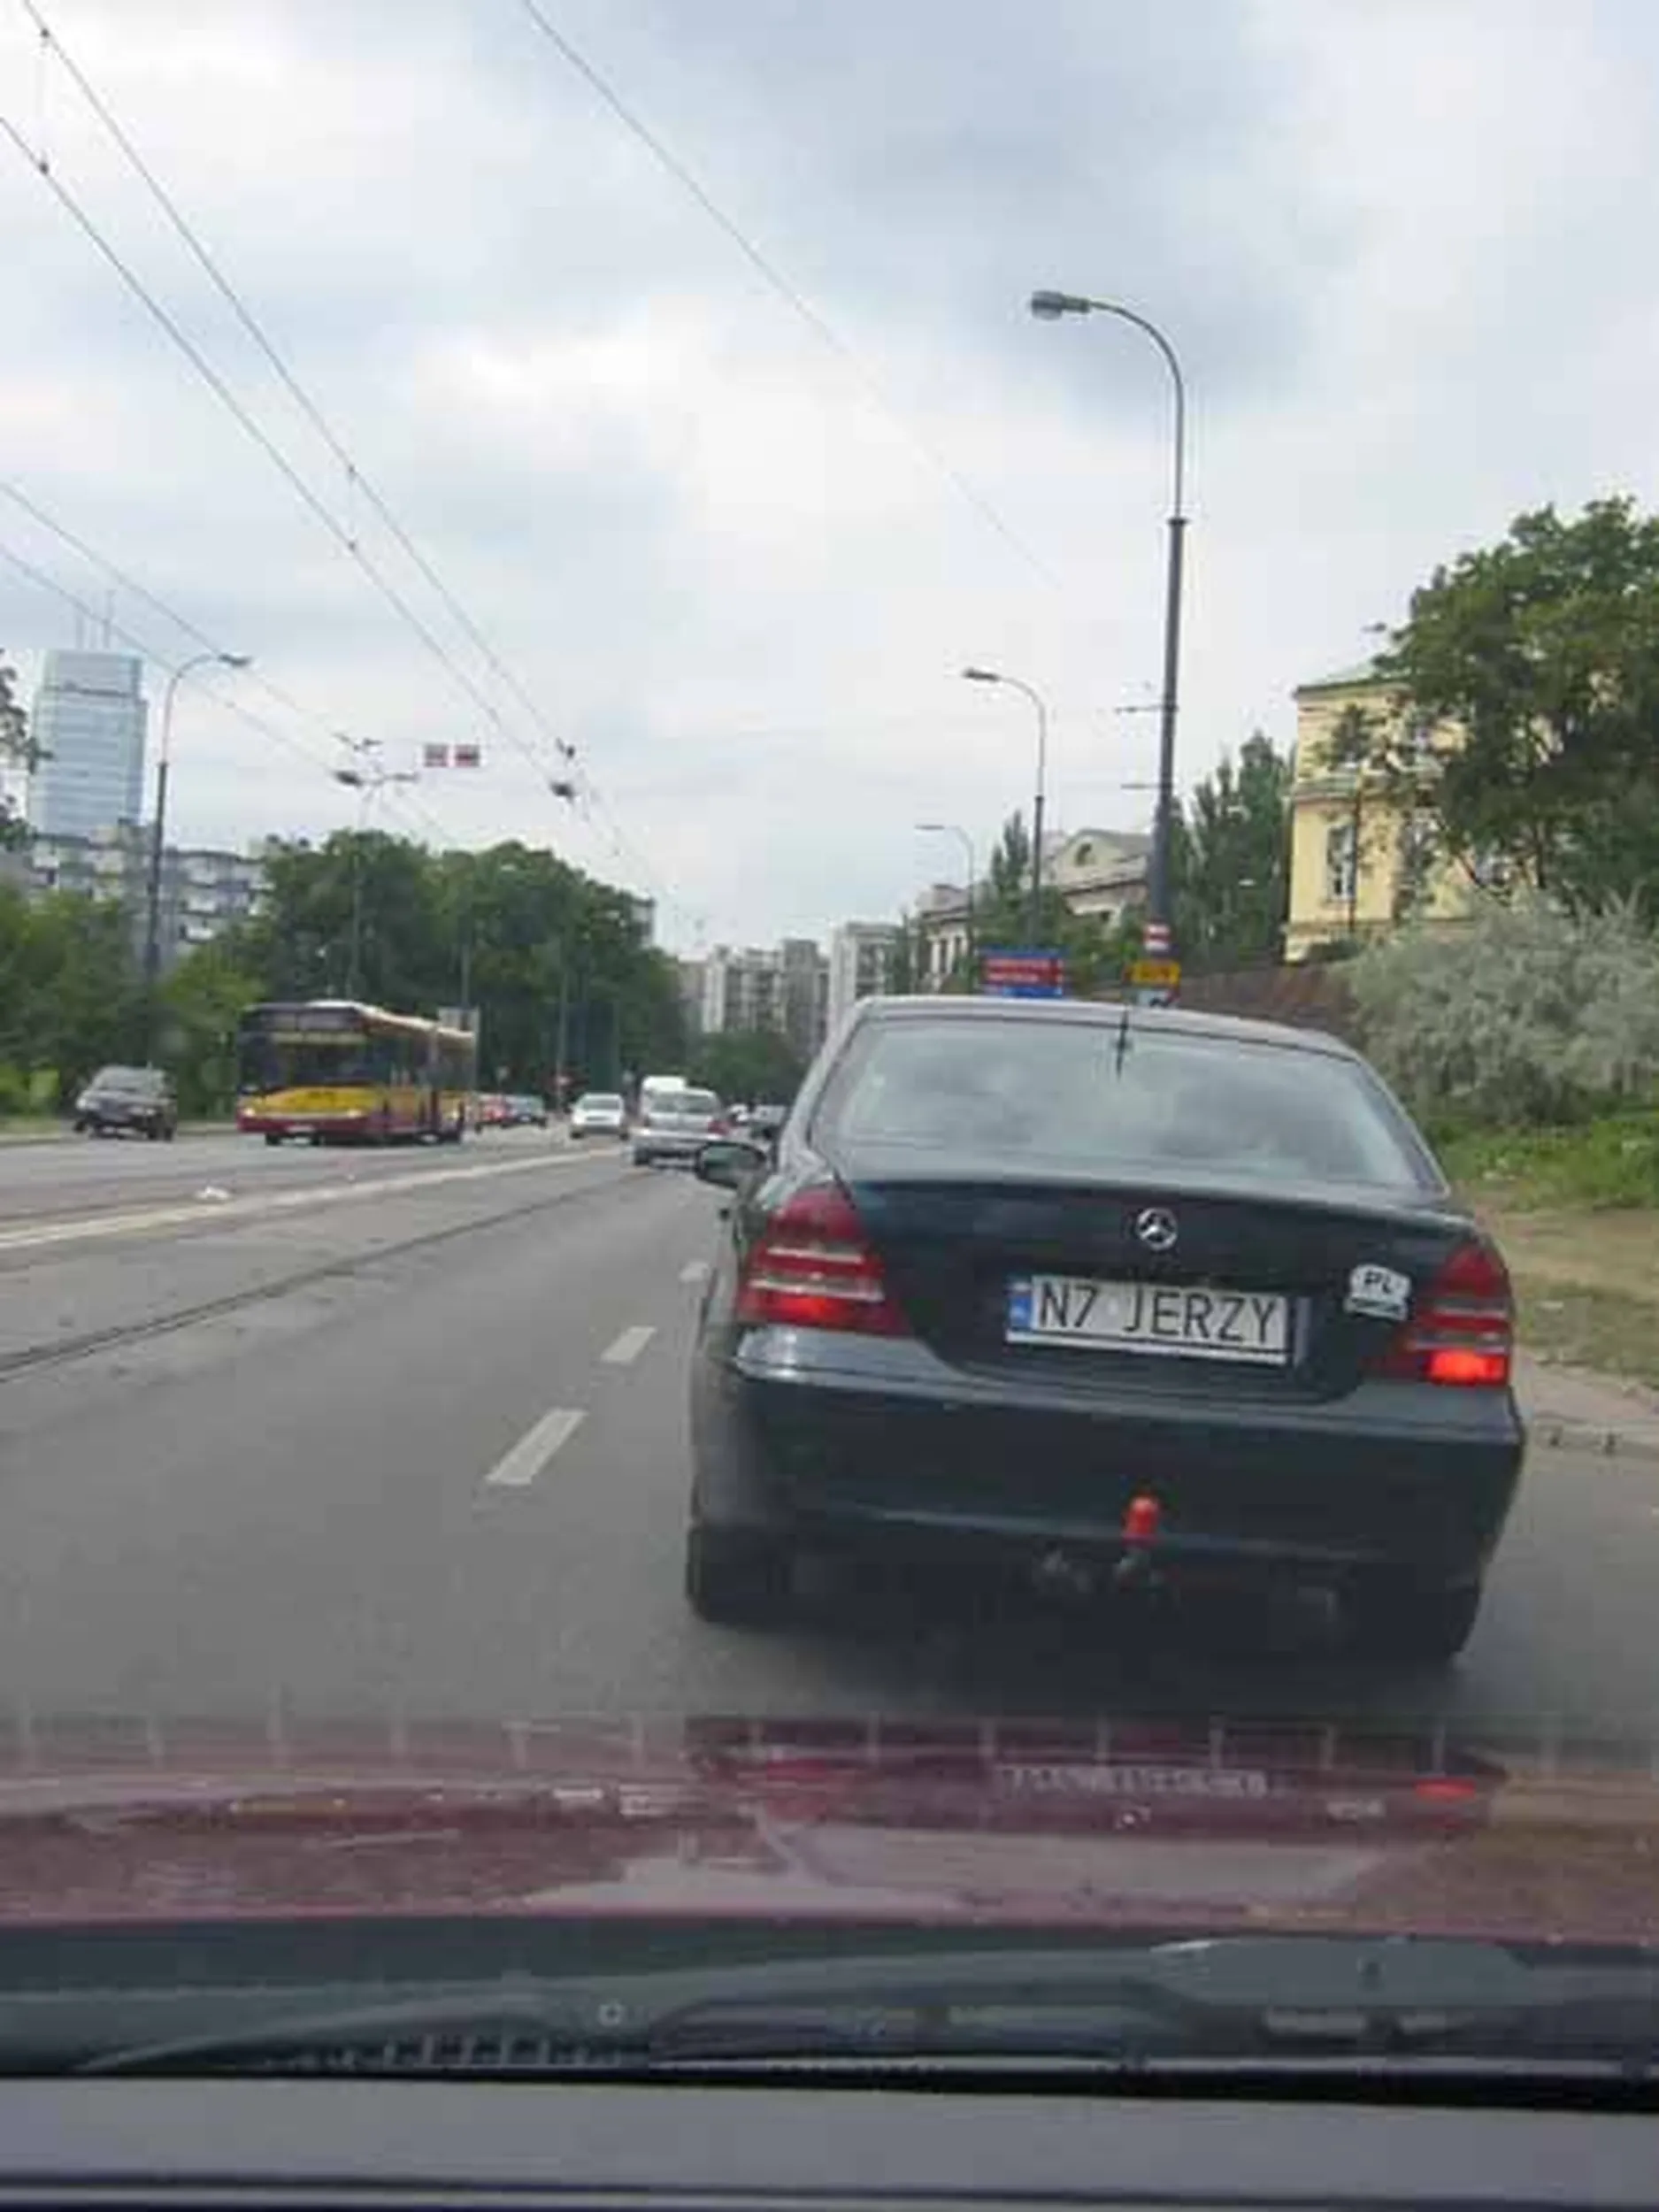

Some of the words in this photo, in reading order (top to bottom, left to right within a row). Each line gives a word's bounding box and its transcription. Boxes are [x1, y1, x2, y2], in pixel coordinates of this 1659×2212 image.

[1363, 1271, 1395, 1295] PL
[1040, 1280, 1099, 1329] N7
[1122, 1283, 1276, 1344] JERZY
